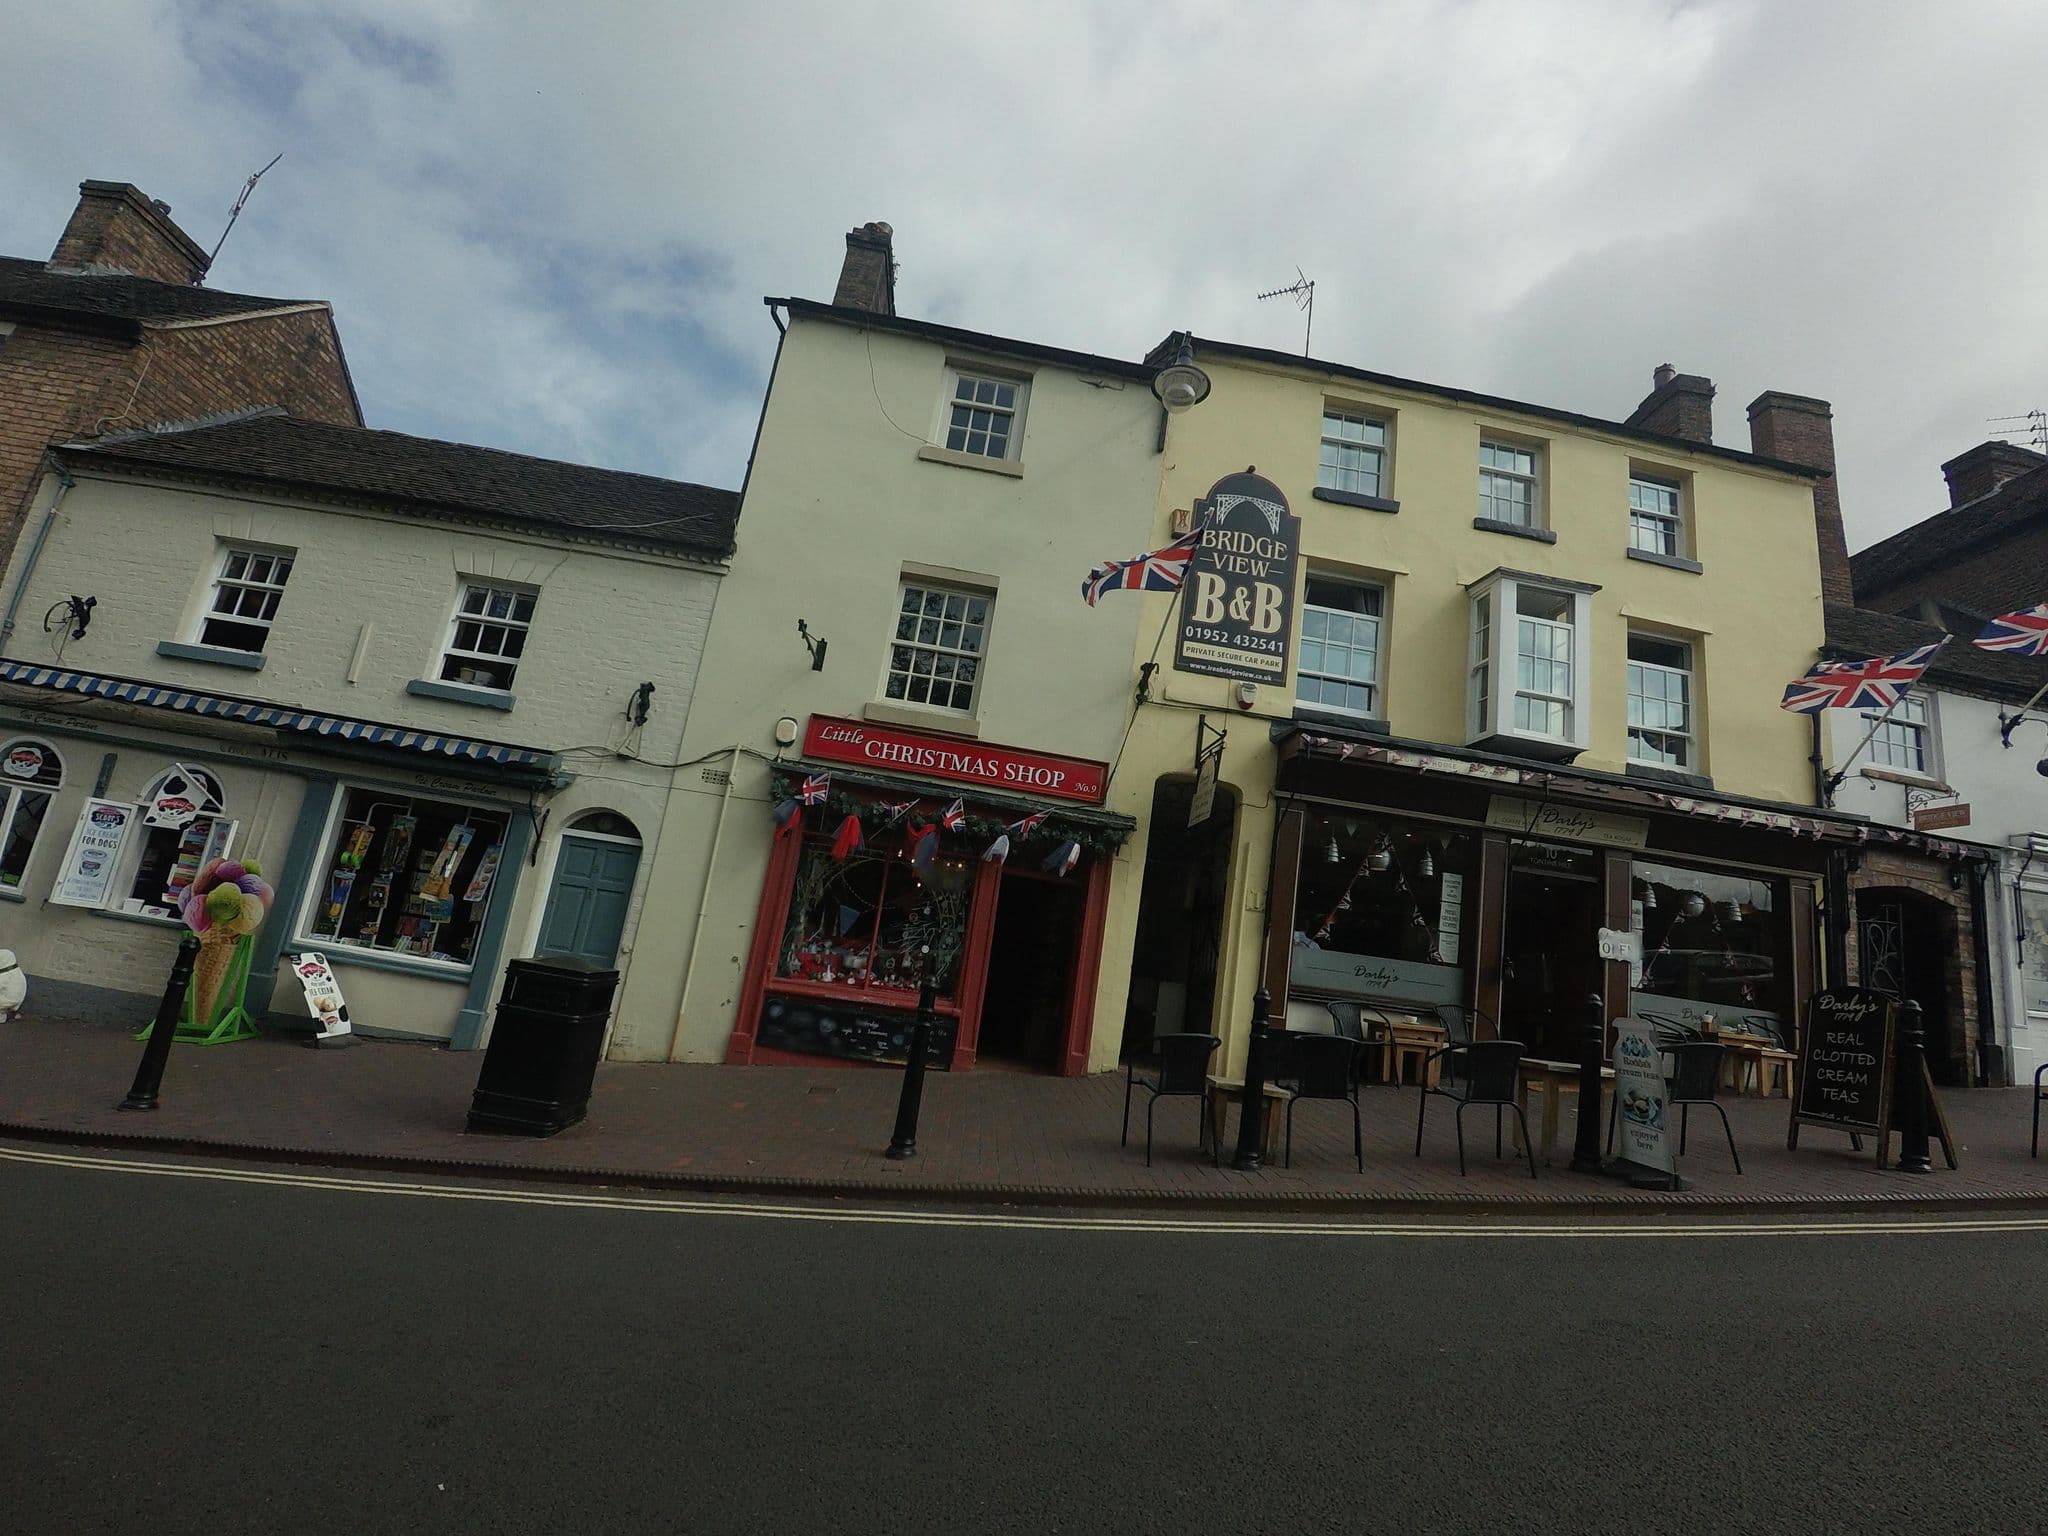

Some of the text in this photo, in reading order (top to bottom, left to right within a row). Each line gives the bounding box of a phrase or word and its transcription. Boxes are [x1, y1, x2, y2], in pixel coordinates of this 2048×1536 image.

[1202, 529, 1289, 561] BRIDGE
[1212, 553, 1271, 577] VIEW
[1192, 572, 1284, 632] B&B
[1185, 625, 1284, 653] 01952 432541
[1186, 646, 1281, 668] PRIVATE SECURE CAR PARK
[820, 725, 864, 744] Little
[864, 740, 999, 778] CHRISTMAS
[1003, 762, 1066, 789] SHOP
[1542, 808, 1597, 837] Darby's
[81, 836, 119, 849] FOR DOGS
[1354, 964, 1400, 989] Darby's
[1819, 993, 1879, 1022] Darby's
[1825, 1032, 1865, 1046] REAL
[1812, 1048, 1876, 1066] CLOTTED
[1618, 1067, 1660, 1081] cream teas
[1816, 1067, 1869, 1085] CREAM
[1822, 1087, 1861, 1104] TEAS
[1630, 1129, 1659, 1143] enjoyed
[1637, 1138, 1654, 1151] here
